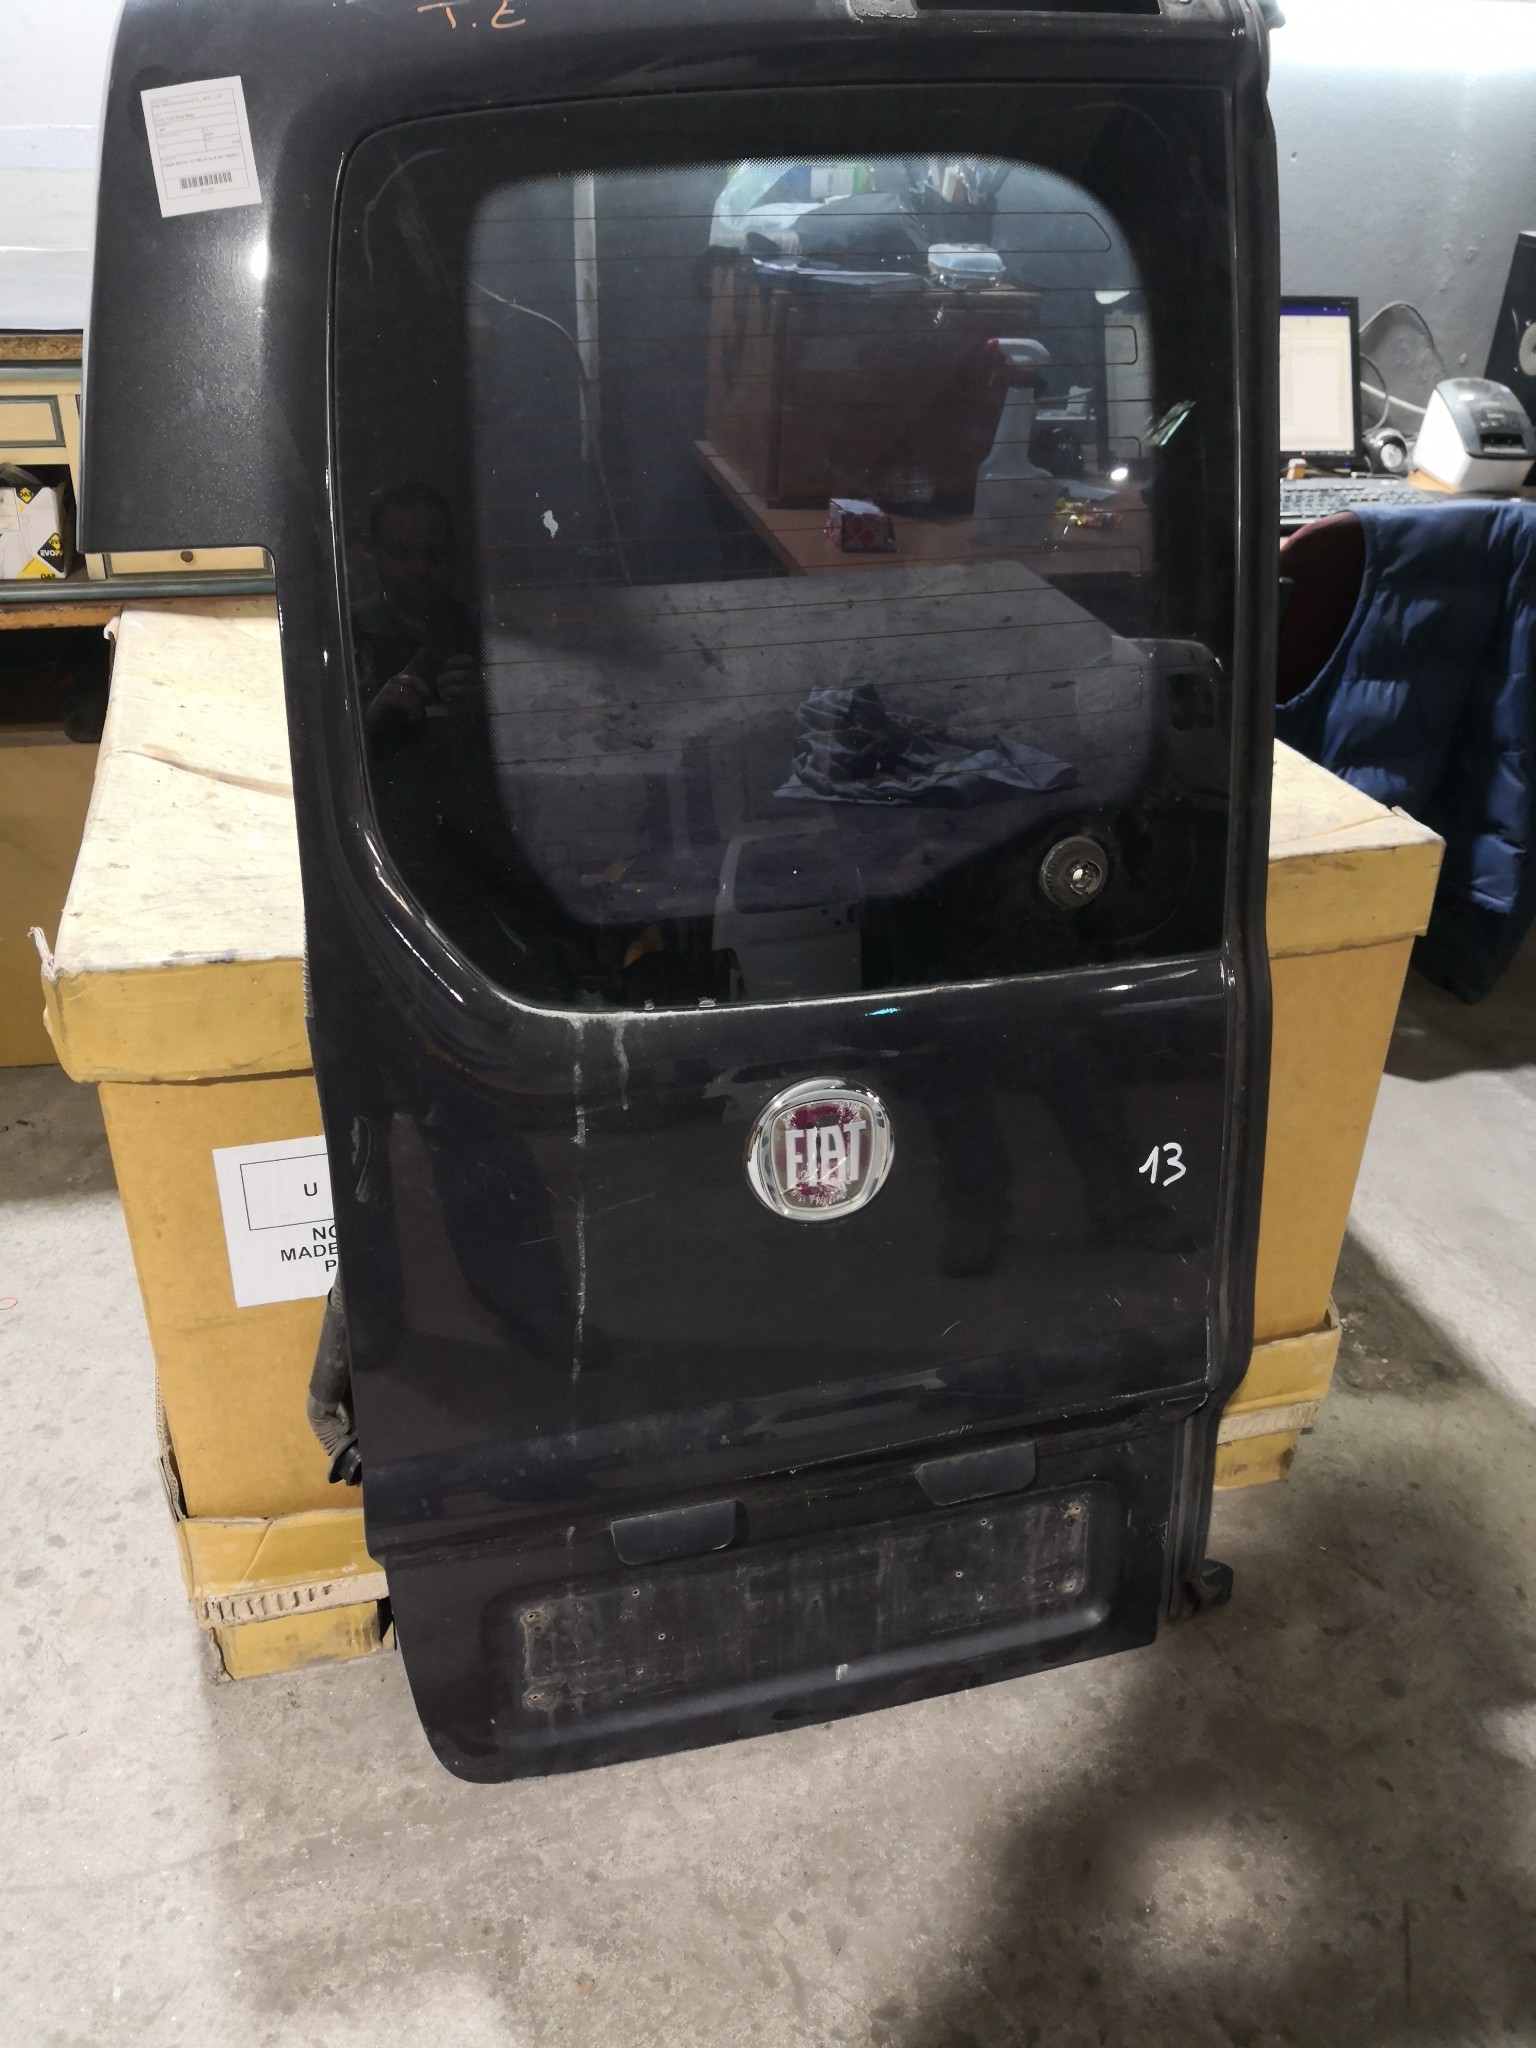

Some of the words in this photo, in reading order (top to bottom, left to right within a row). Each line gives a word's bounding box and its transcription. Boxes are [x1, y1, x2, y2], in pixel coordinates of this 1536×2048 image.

[784, 1119, 867, 1190] FIAT
[1138, 1141, 1187, 1187] 13
[280, 1242, 339, 1262] MADE
